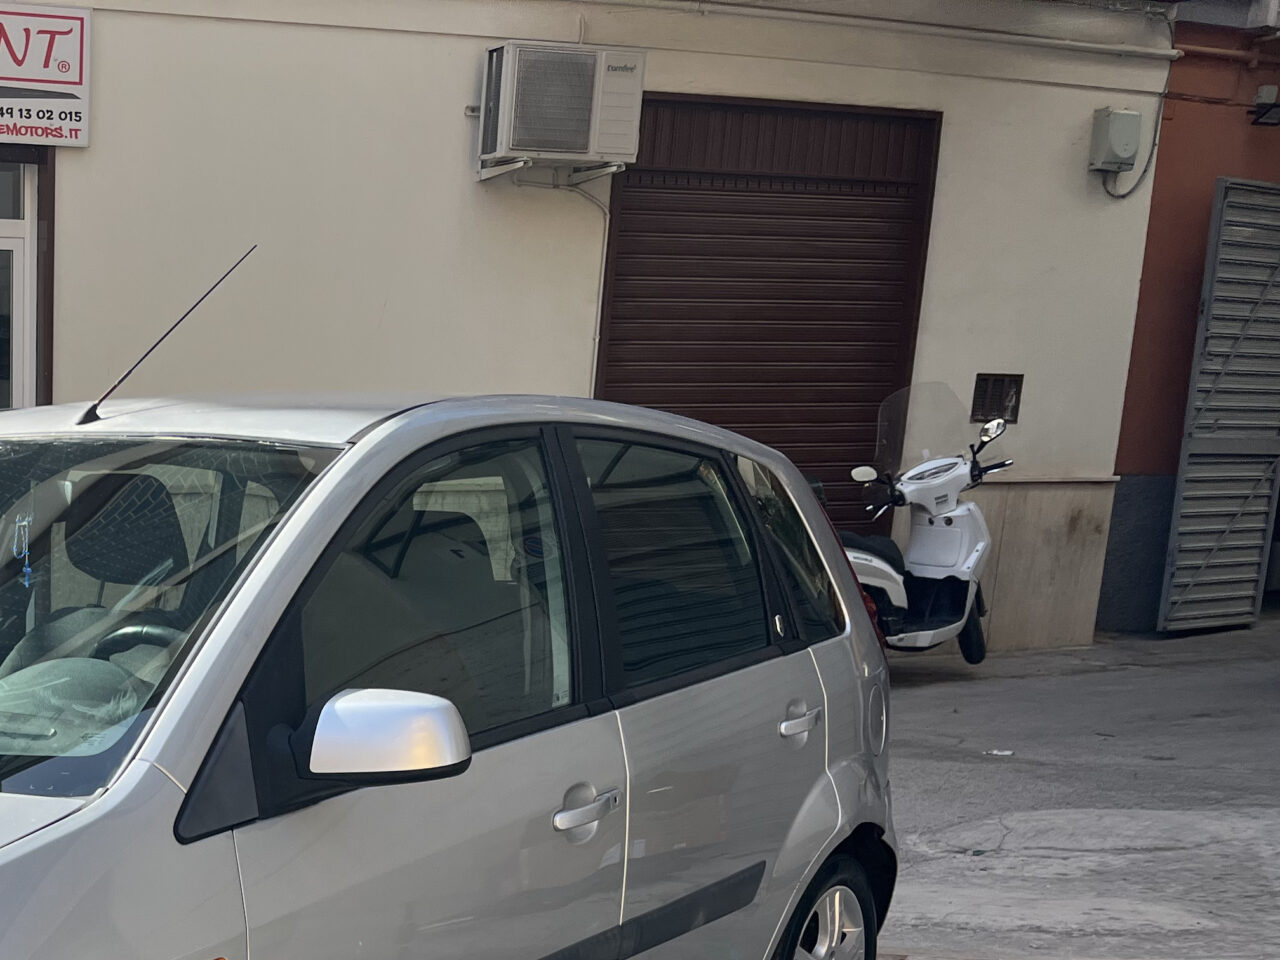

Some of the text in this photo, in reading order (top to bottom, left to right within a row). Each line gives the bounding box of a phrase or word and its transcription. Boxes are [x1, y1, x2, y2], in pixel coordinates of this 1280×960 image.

[17, 108, 32, 119] 13
[36, 109, 54, 121] 02
[58, 111, 82, 122] 015
